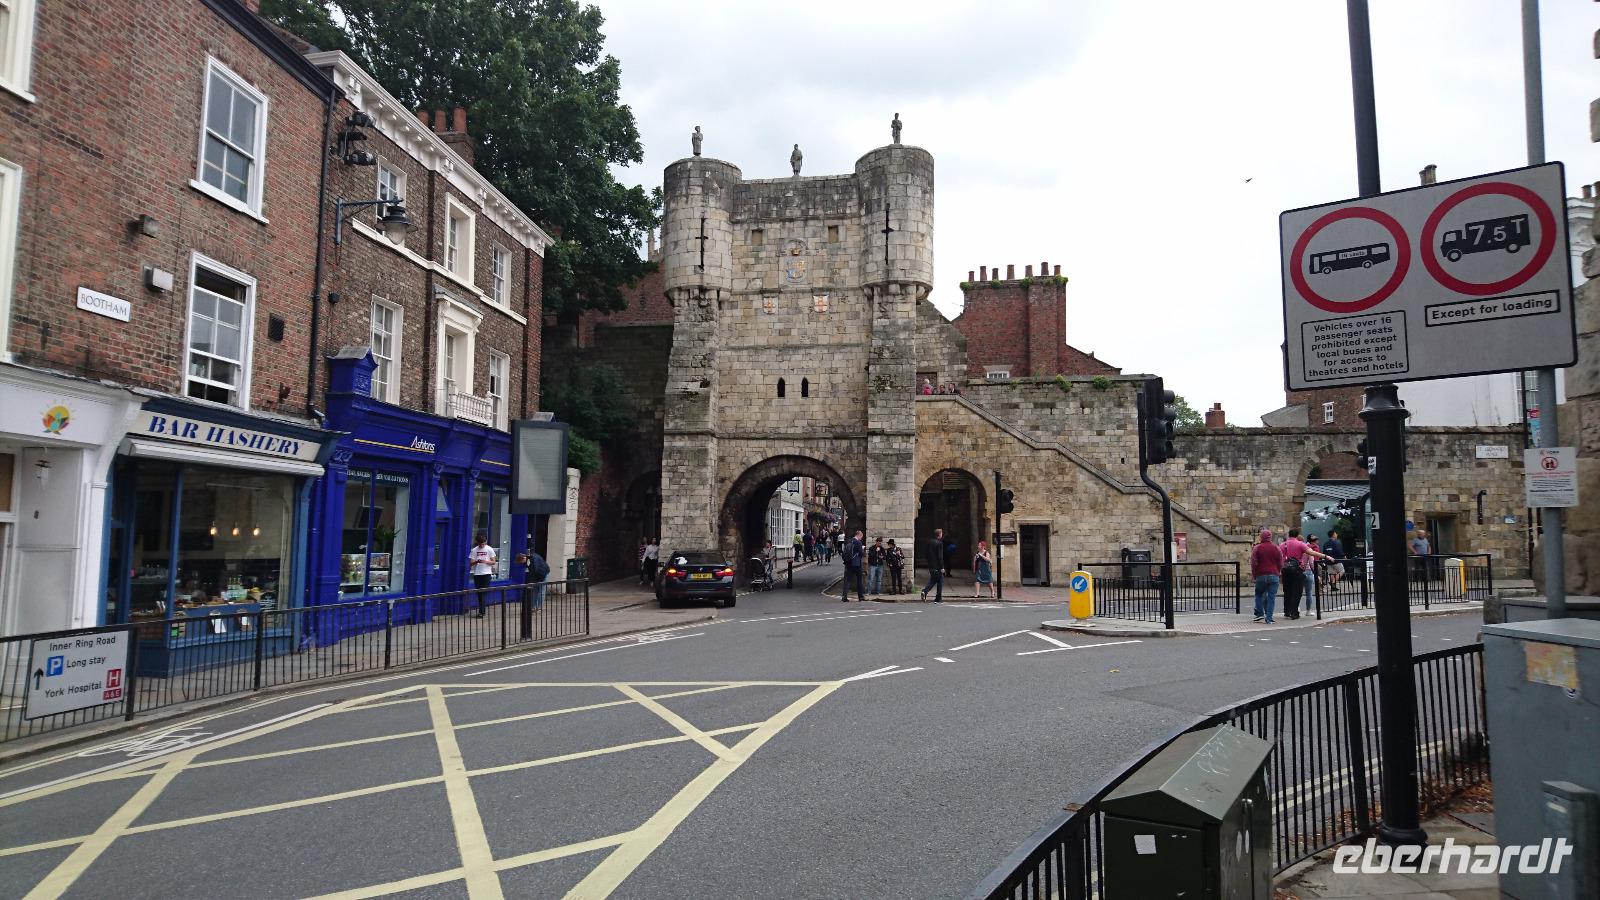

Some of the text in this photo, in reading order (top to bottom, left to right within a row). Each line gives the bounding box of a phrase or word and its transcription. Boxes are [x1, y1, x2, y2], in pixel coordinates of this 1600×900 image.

[80, 293, 127, 316] BOOTHAM
[1432, 299, 1553, 319] Except for loading
[1313, 316, 1392, 332] Vehicles over 16
[1314, 326, 1393, 342] passenger seats
[1311, 334, 1397, 351] prohibited except
[1317, 344, 1393, 358] local buses and
[1308, 361, 1404, 377] theatres and hotels
[1323, 359, 1337, 367] for
[1340, 356, 1373, 365] access
[148, 416, 304, 456] BAR HASHERY
[410, 435, 436, 451] Ashtons
[49, 636, 116, 651] Inner Ring Road
[66, 656, 106, 668] Long stay
[45, 681, 102, 698] York Hospital
